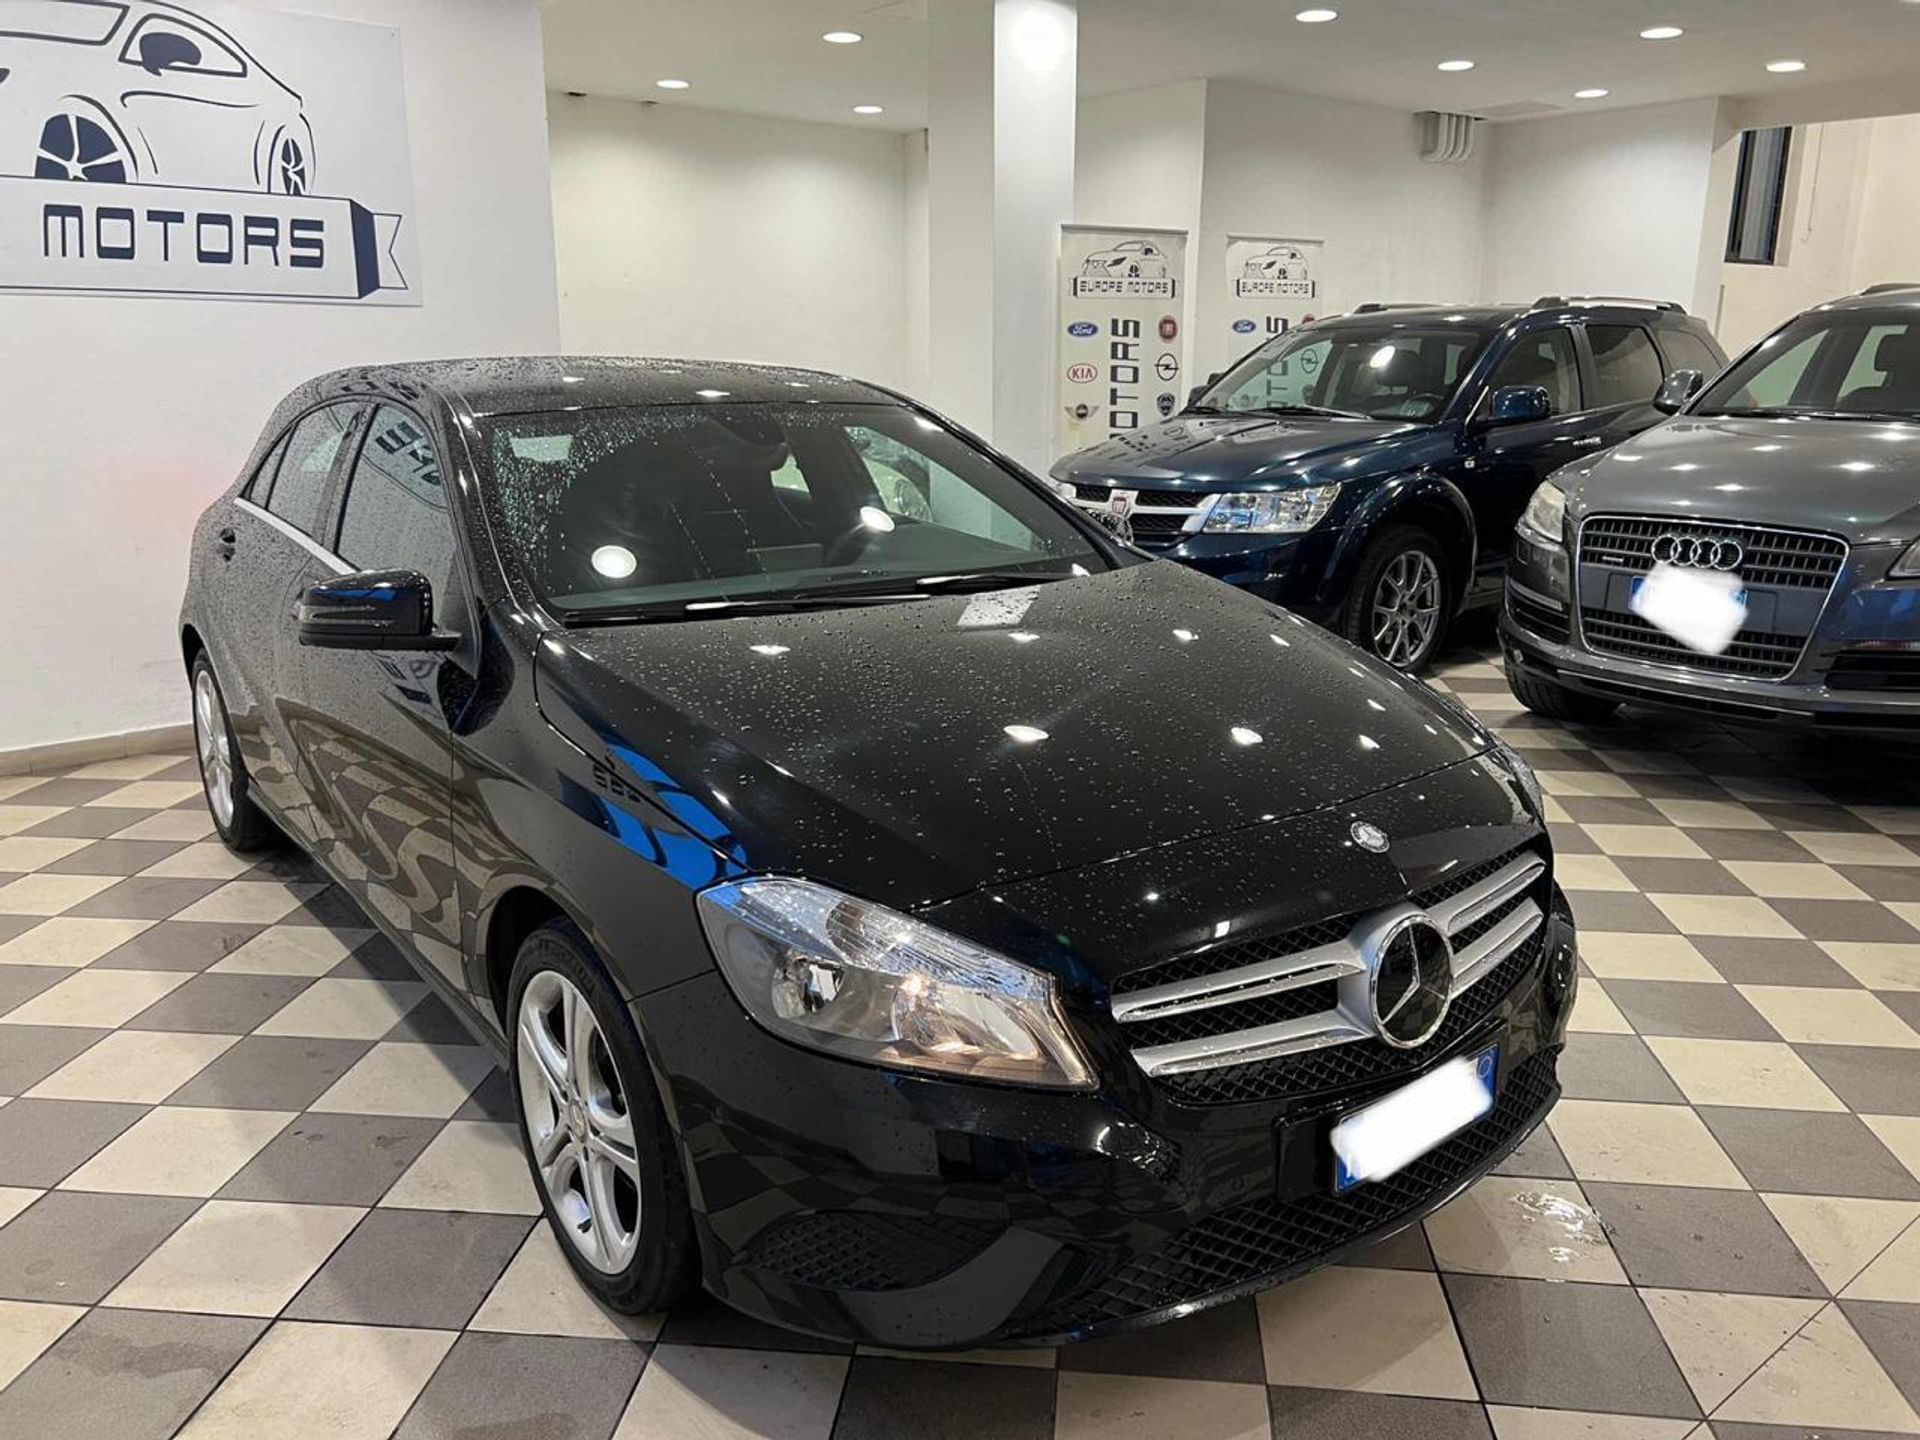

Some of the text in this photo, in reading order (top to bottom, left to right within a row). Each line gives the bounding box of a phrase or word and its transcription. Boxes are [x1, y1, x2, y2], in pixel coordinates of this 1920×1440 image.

[43, 203, 325, 269] MOTORS
[1079, 280, 1123, 293] EUROPE
[1072, 368, 1093, 379] KIA
[1109, 318, 1141, 440] OTORS
